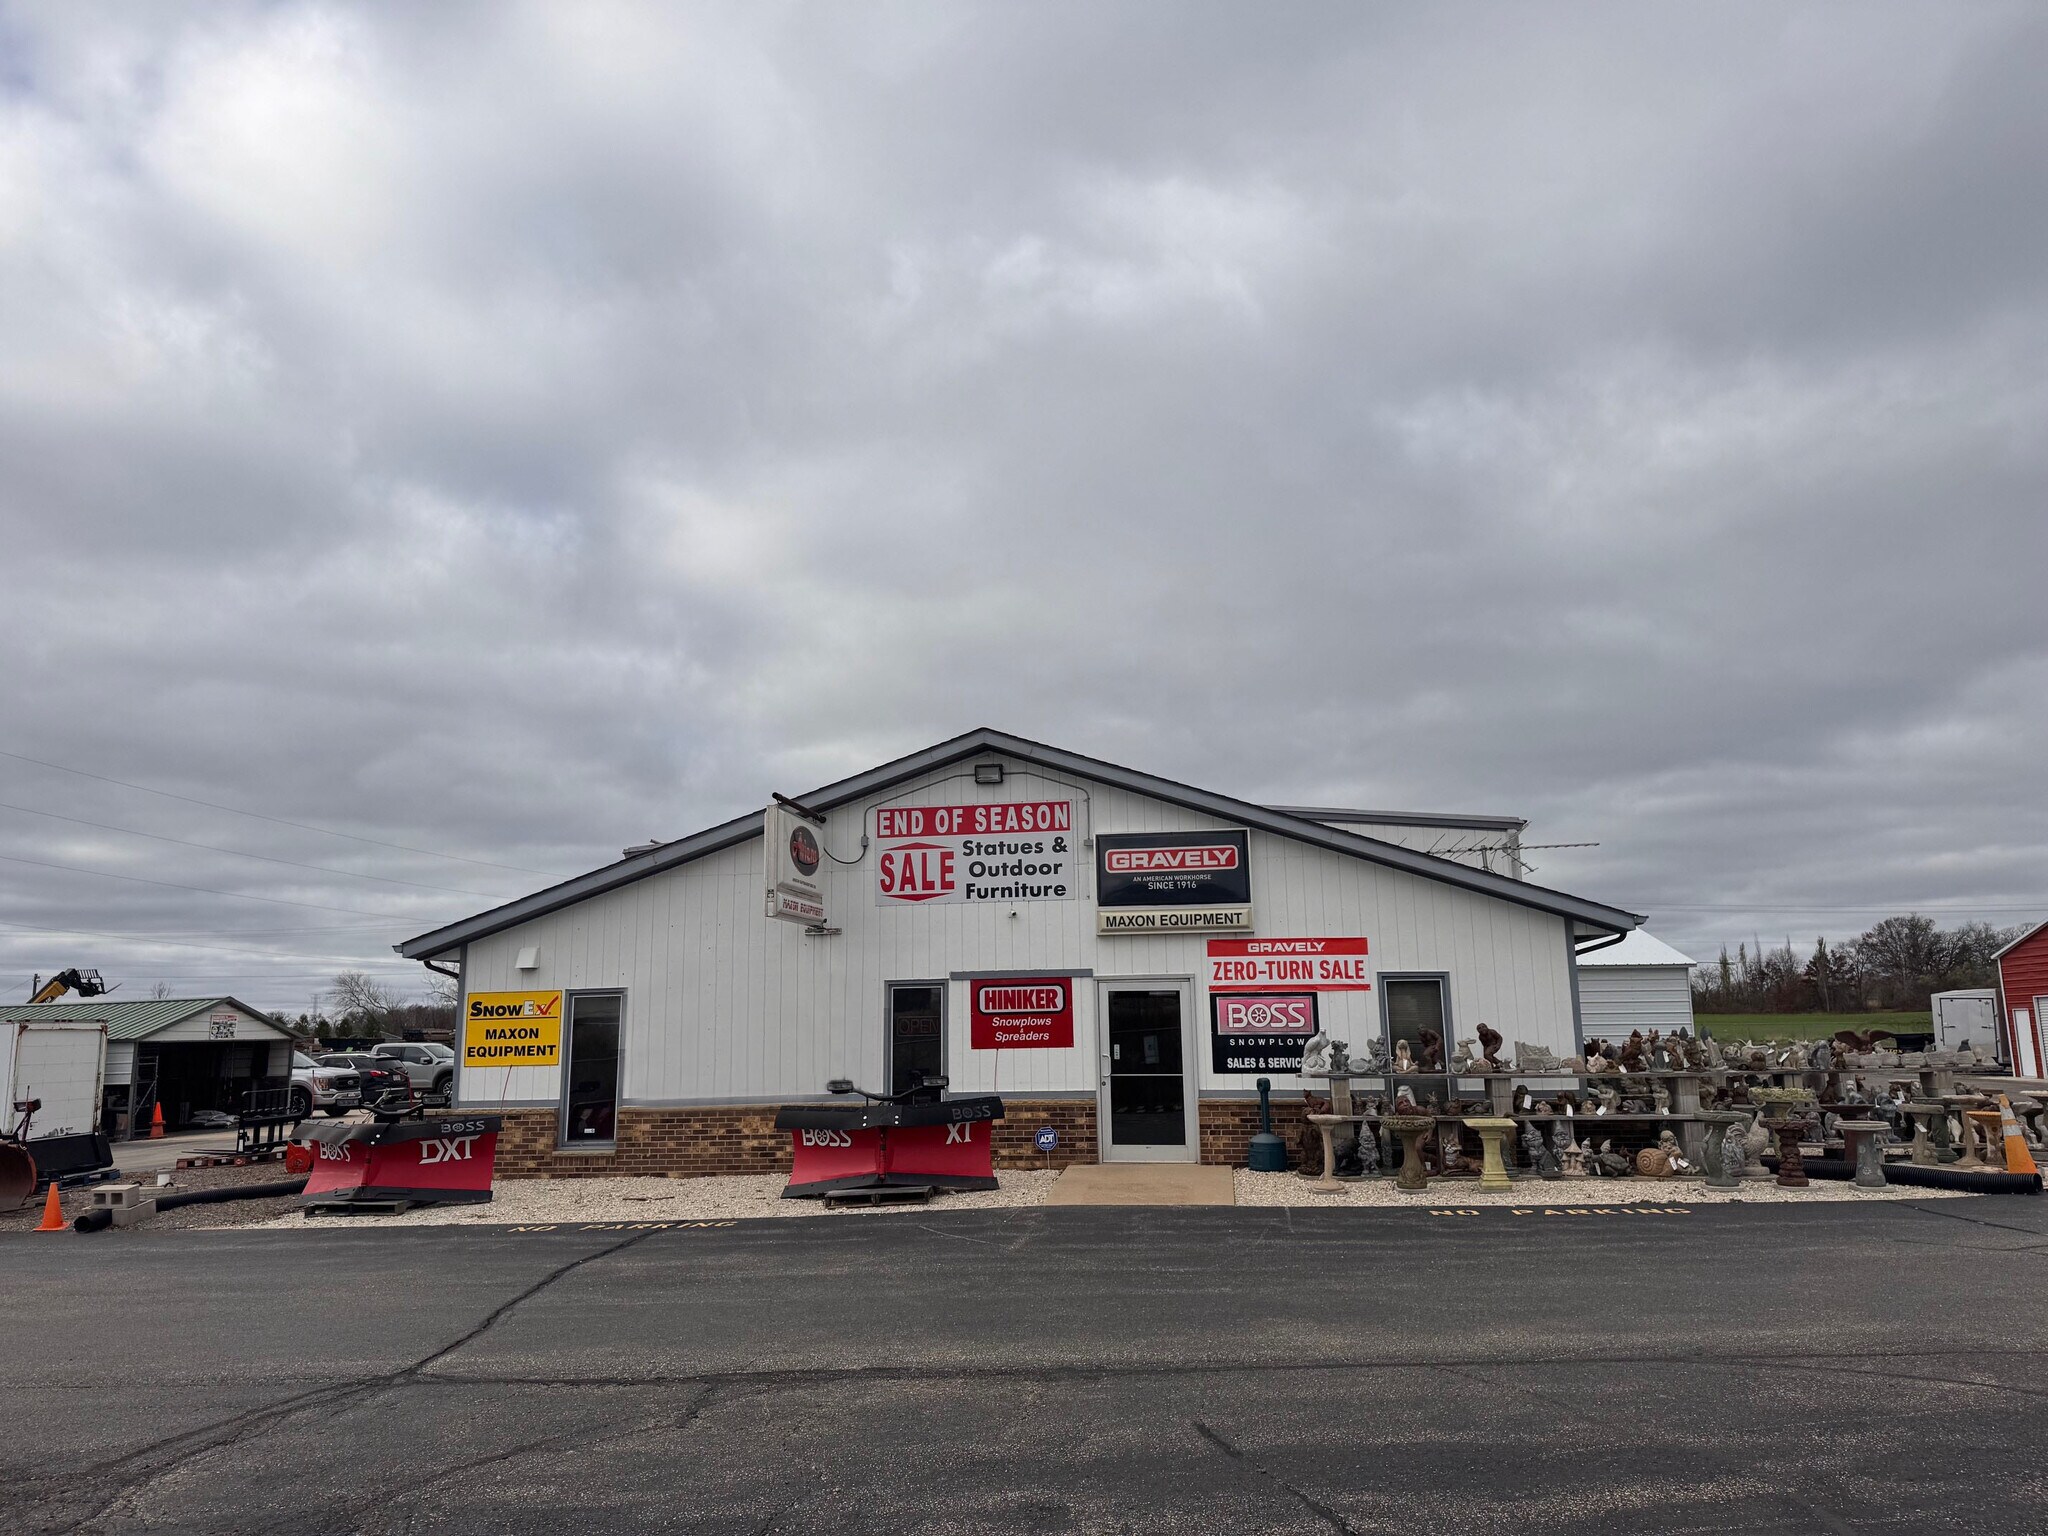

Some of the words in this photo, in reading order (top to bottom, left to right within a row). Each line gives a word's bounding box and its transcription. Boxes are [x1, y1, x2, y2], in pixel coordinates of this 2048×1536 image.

[879, 811, 923, 835] END
[935, 809, 963, 833] OF
[975, 804, 1069, 831] SEASON
[962, 839, 1044, 857] Statues
[1052, 836, 1068, 853] &
[1111, 849, 1233, 869] GRAVELY
[879, 851, 955, 893] SALE
[968, 860, 1063, 878] Outdoor
[965, 883, 1067, 900] Furniture
[1148, 882, 1174, 890] SINCE
[1177, 881, 1197, 889] 1916
[1105, 914, 1156, 928] MAXON
[1160, 912, 1243, 926] EQUIPMENT
[1247, 942, 1326, 953] GRAVELY
[1213, 961, 1314, 981] ZERO-TURN
[1319, 960, 1365, 980] SALE
[984, 989, 1059, 1010] HINIKER
[992, 1016, 1052, 1027] Snowplows
[1227, 1003, 1306, 1028] BOSS
[485, 1028, 539, 1040] MAXON
[899, 1018, 939, 1034] OPEN
[995, 1031, 1050, 1042] Spreaders
[1229, 1038, 1305, 1046] SNOWPLOW
[467, 1045, 556, 1058] EQUIPMENT
[1227, 1057, 1257, 1069] SALES
[1259, 1058, 1266, 1068] &
[1268, 1057, 1303, 1068] SERVIC
[952, 1105, 991, 1120] BOSS
[441, 1120, 485, 1133] BOSS
[946, 1121, 976, 1144] XT
[802, 1128, 851, 1147] BOSS
[1039, 1134, 1054, 1143] ADT
[319, 1141, 350, 1162] BOSS
[419, 1135, 480, 1165] DXT
[1511, 1208, 1691, 1216] PARKING
